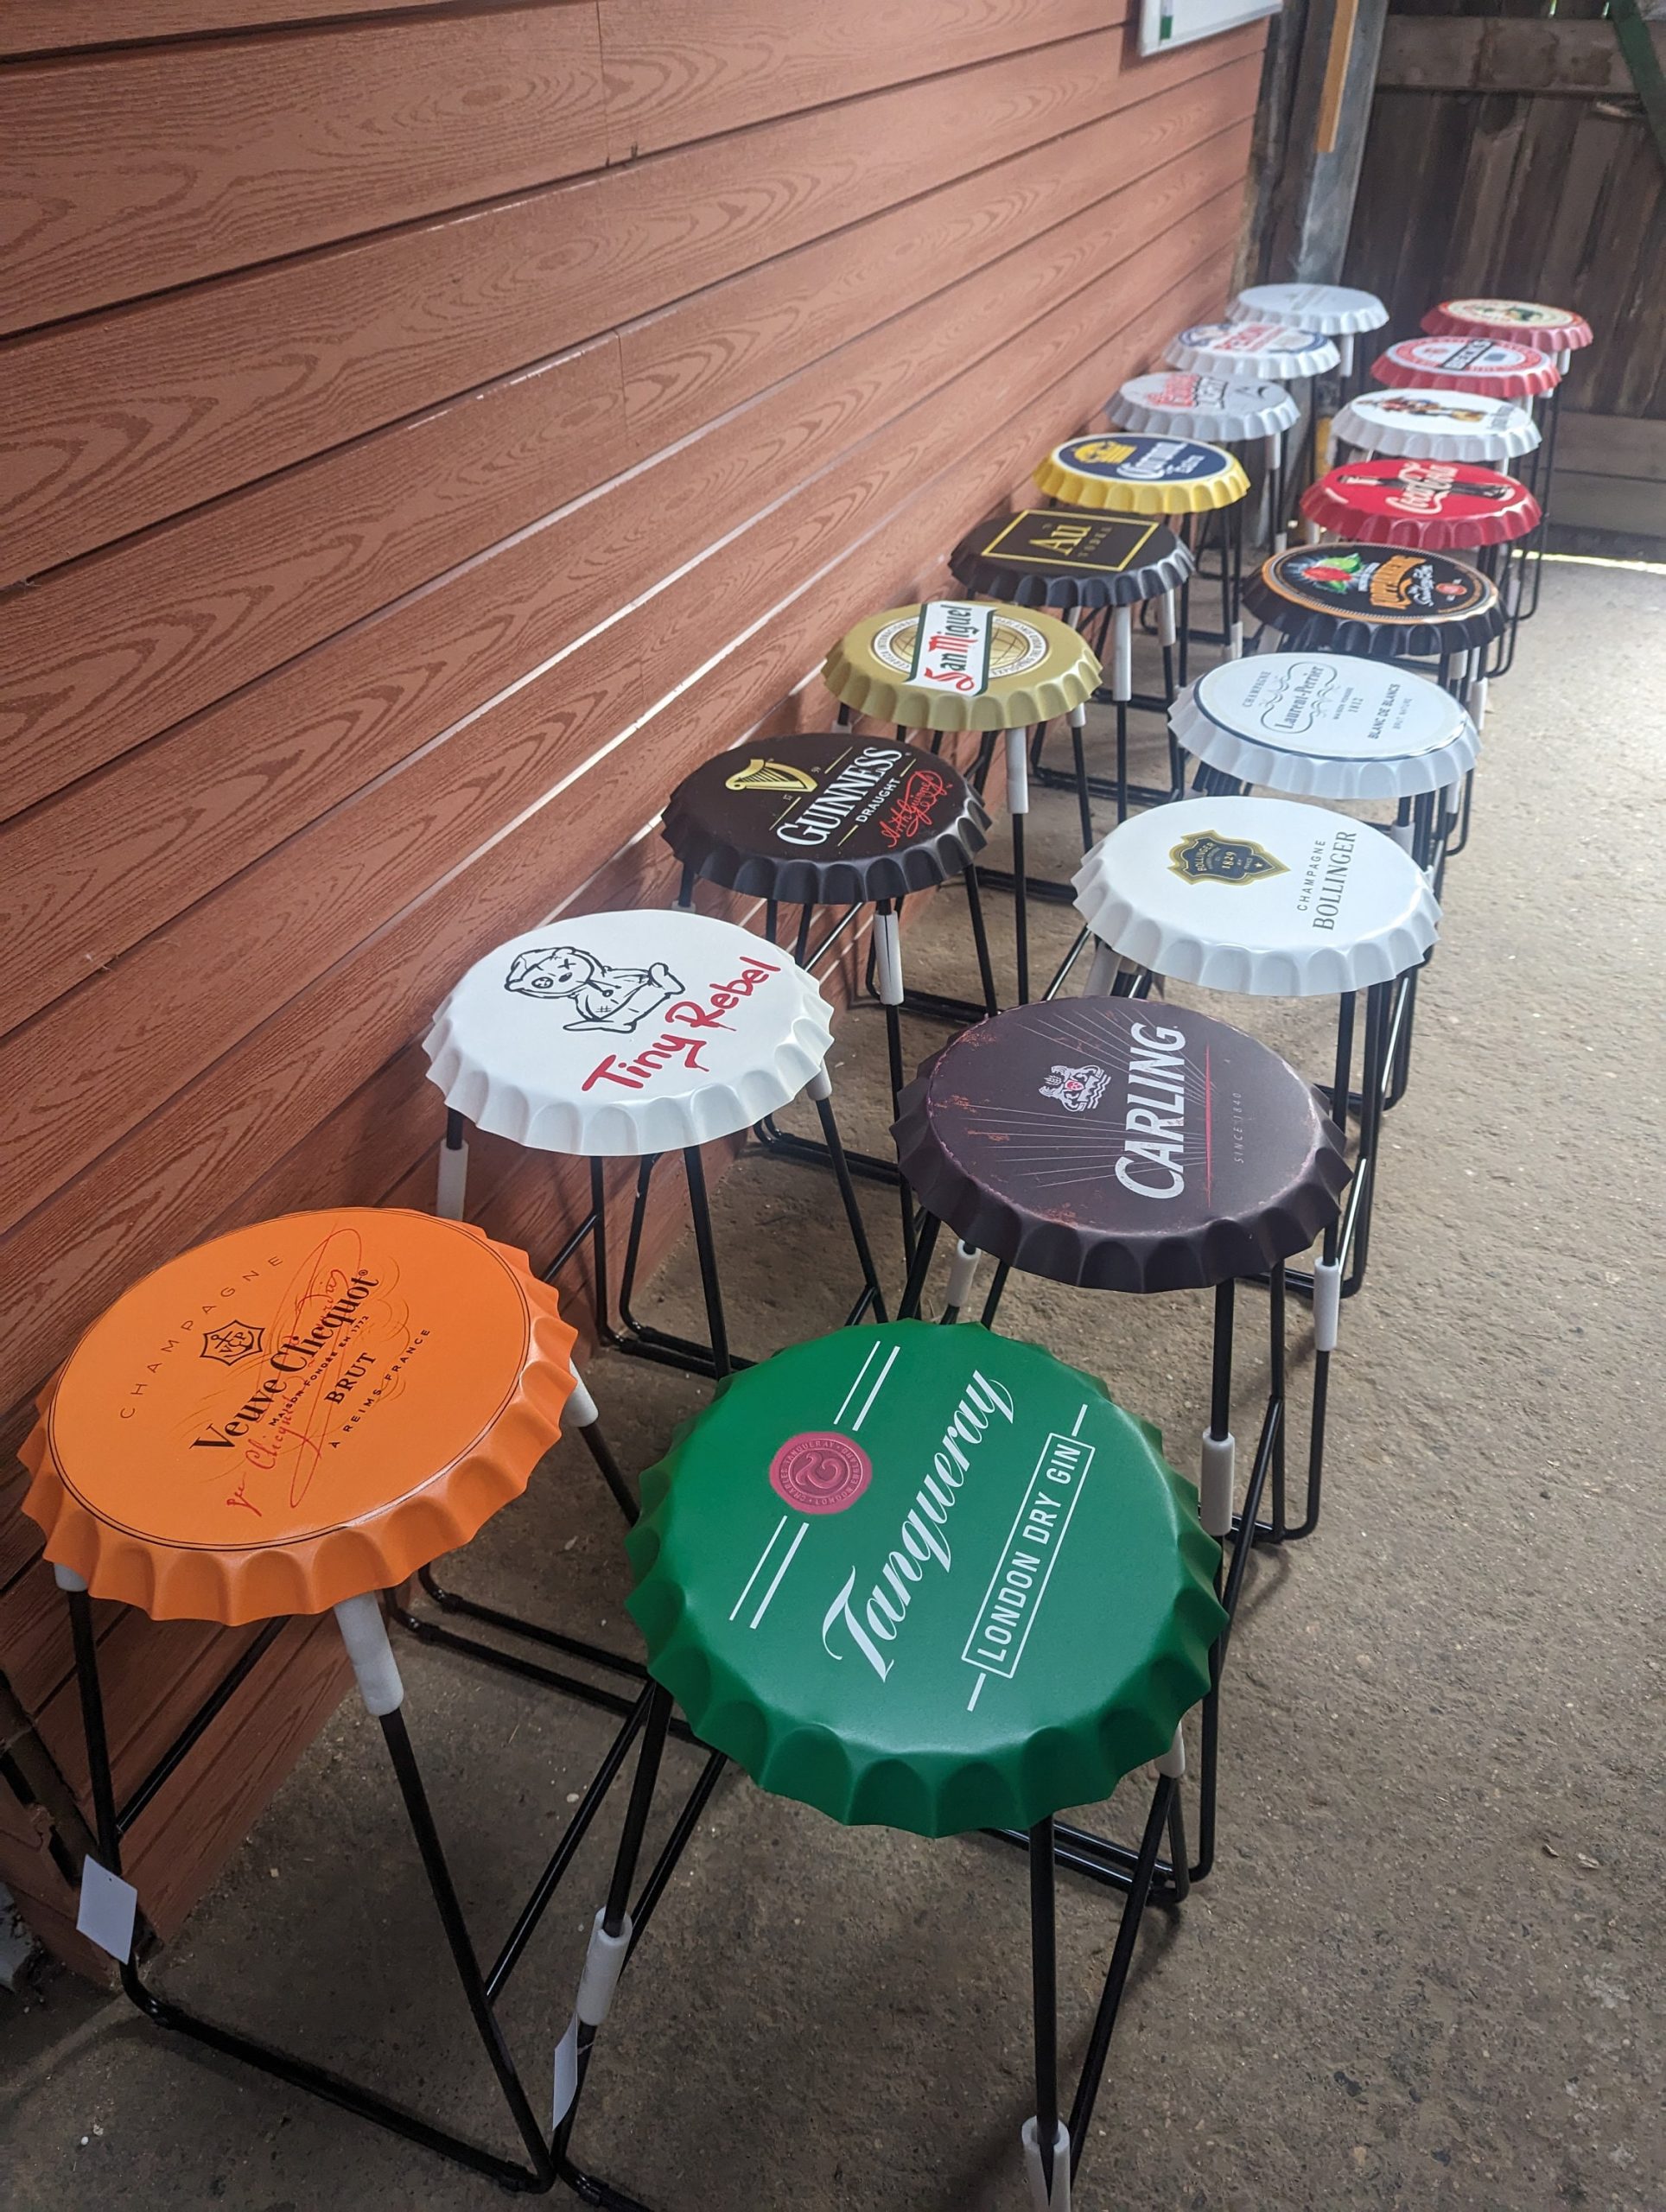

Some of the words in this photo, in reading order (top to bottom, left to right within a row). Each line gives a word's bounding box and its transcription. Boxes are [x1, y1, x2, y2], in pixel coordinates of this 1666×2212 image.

[1028, 524, 1092, 556] Au
[928, 603, 981, 654] Miguel
[924, 650, 975, 690] San
[1242, 671, 1271, 707] CHAMPAGNE
[1381, 683, 1400, 707] BLANCS
[1275, 665, 1324, 729] Laurent-Perrier
[1377, 707, 1390, 717] DE
[1367, 718, 1386, 740] BLANC
[777, 747, 902, 846] GUINNESS
[855, 778, 900, 823] DRAUGHT
[1221, 851, 1237, 869] 1829
[1296, 839, 1326, 912] CHAMPAGNE
[1312, 830, 1358, 931] BOLLINGER
[582, 1033, 709, 1091] Tiny
[664, 956, 781, 1032] Rebel
[1114, 1022, 1186, 1200] CARLING
[1231, 1092, 1243, 1121] 1840
[1233, 1126, 1244, 1164] SINCE
[120, 1255, 284, 1421] CHAMPAGNE
[324, 1352, 377, 1405] BRUT
[343, 1389, 382, 1433] REIMS
[385, 1329, 430, 1381] FRANCE
[188, 1378, 287, 1451] Veuve
[822, 1370, 1014, 1682] Tanqueray
[977, 1551, 1041, 1662] LONDON
[1022, 1492, 1062, 1545] DRY
[1046, 1444, 1082, 1485] GIN
